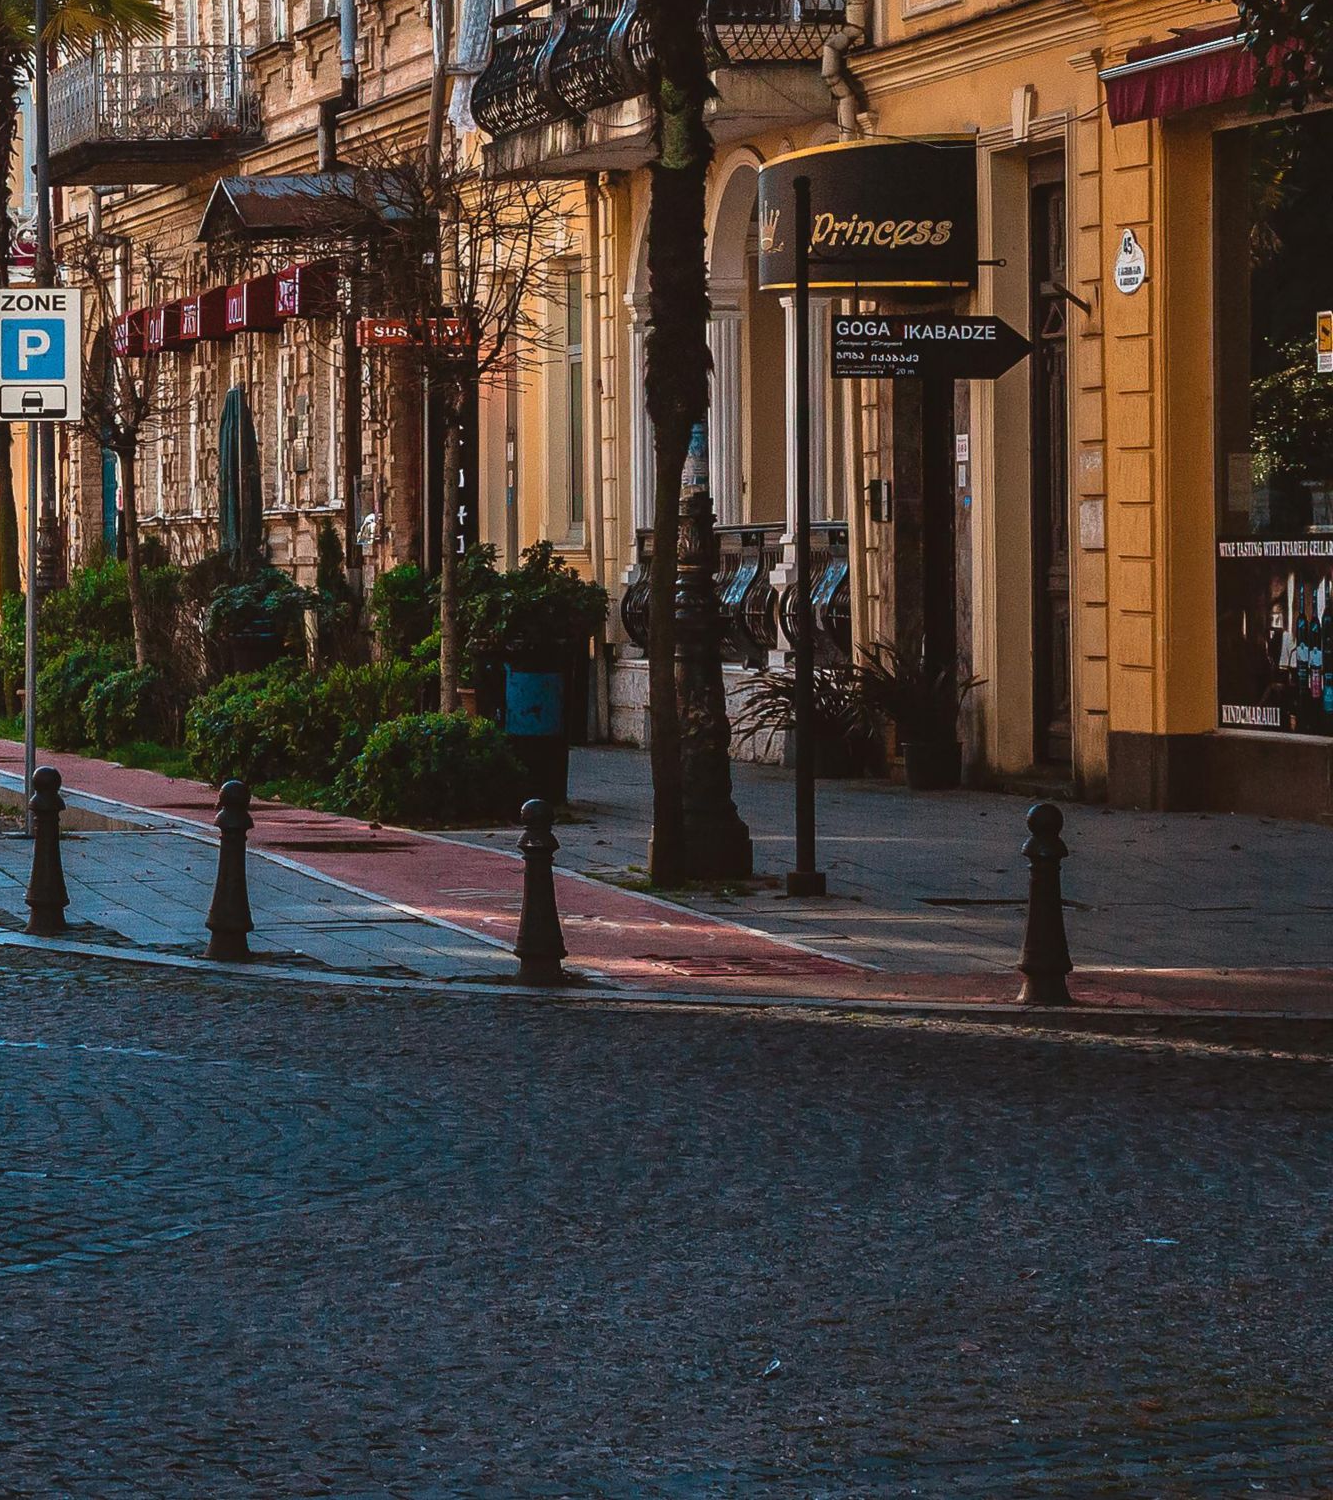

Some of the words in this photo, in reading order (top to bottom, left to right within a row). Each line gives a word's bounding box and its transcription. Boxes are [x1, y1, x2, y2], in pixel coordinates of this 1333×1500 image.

[809, 212, 953, 253] Princess
[0, 295, 66, 311] ZONE
[836, 321, 890, 336] GOGA
[18, 329, 51, 371] P
[1219, 542, 1235, 557] WINE
[1236, 542, 1262, 557] TASTING
[1263, 541, 1280, 556] WITH
